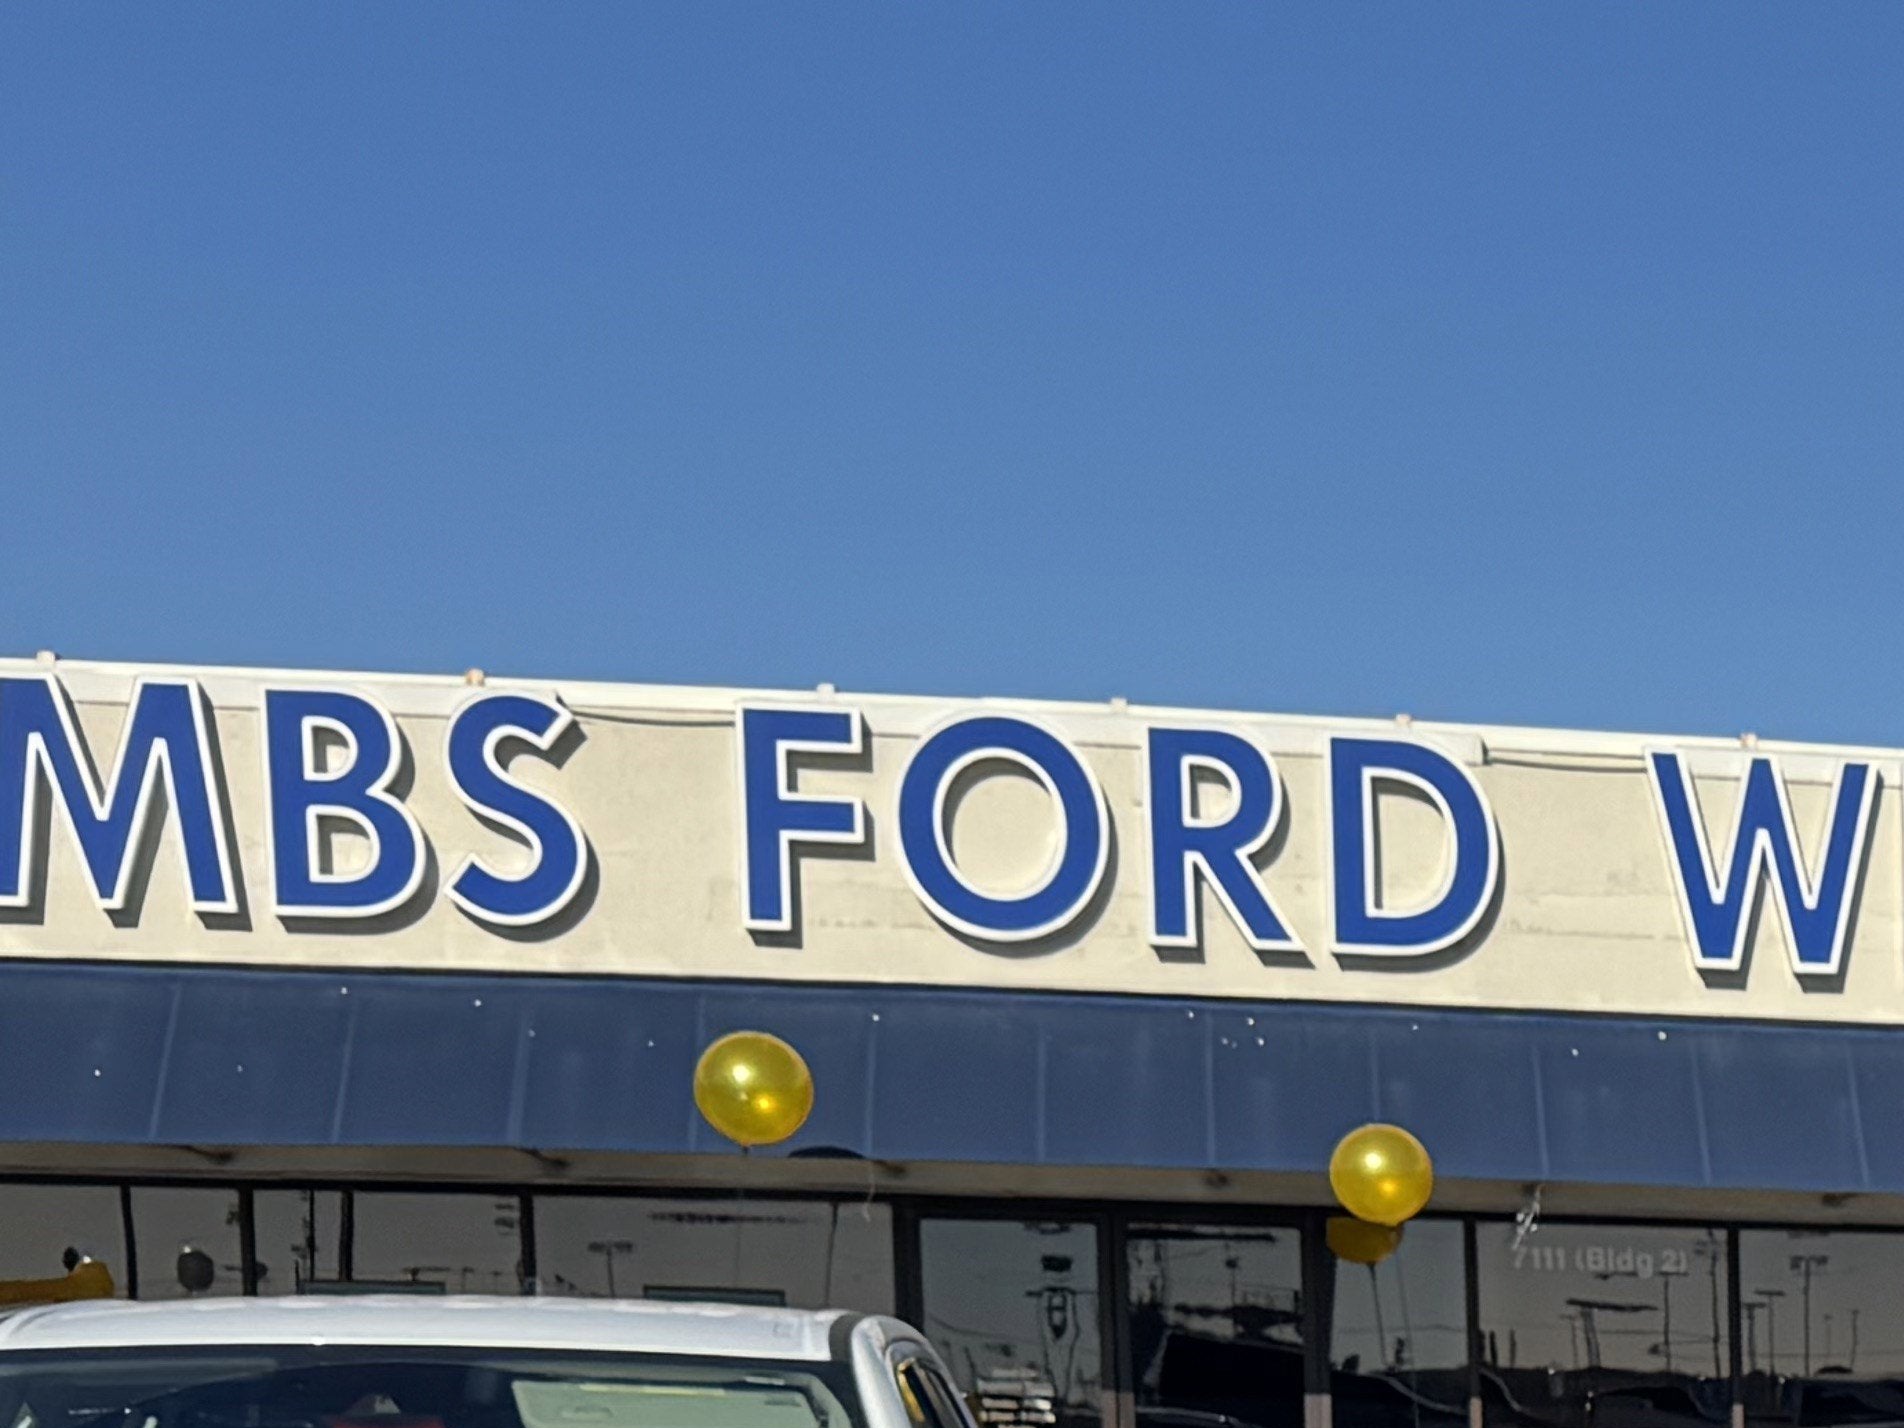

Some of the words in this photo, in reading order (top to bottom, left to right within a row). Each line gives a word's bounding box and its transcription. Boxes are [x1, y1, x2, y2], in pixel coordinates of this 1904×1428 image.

[0, 672, 588, 927] MBS
[734, 697, 1498, 957] FORD
[1514, 1247, 1567, 1271] 7111
[1574, 1247, 1654, 1279] (Bldg
[1661, 1249, 1688, 1273] 2)
